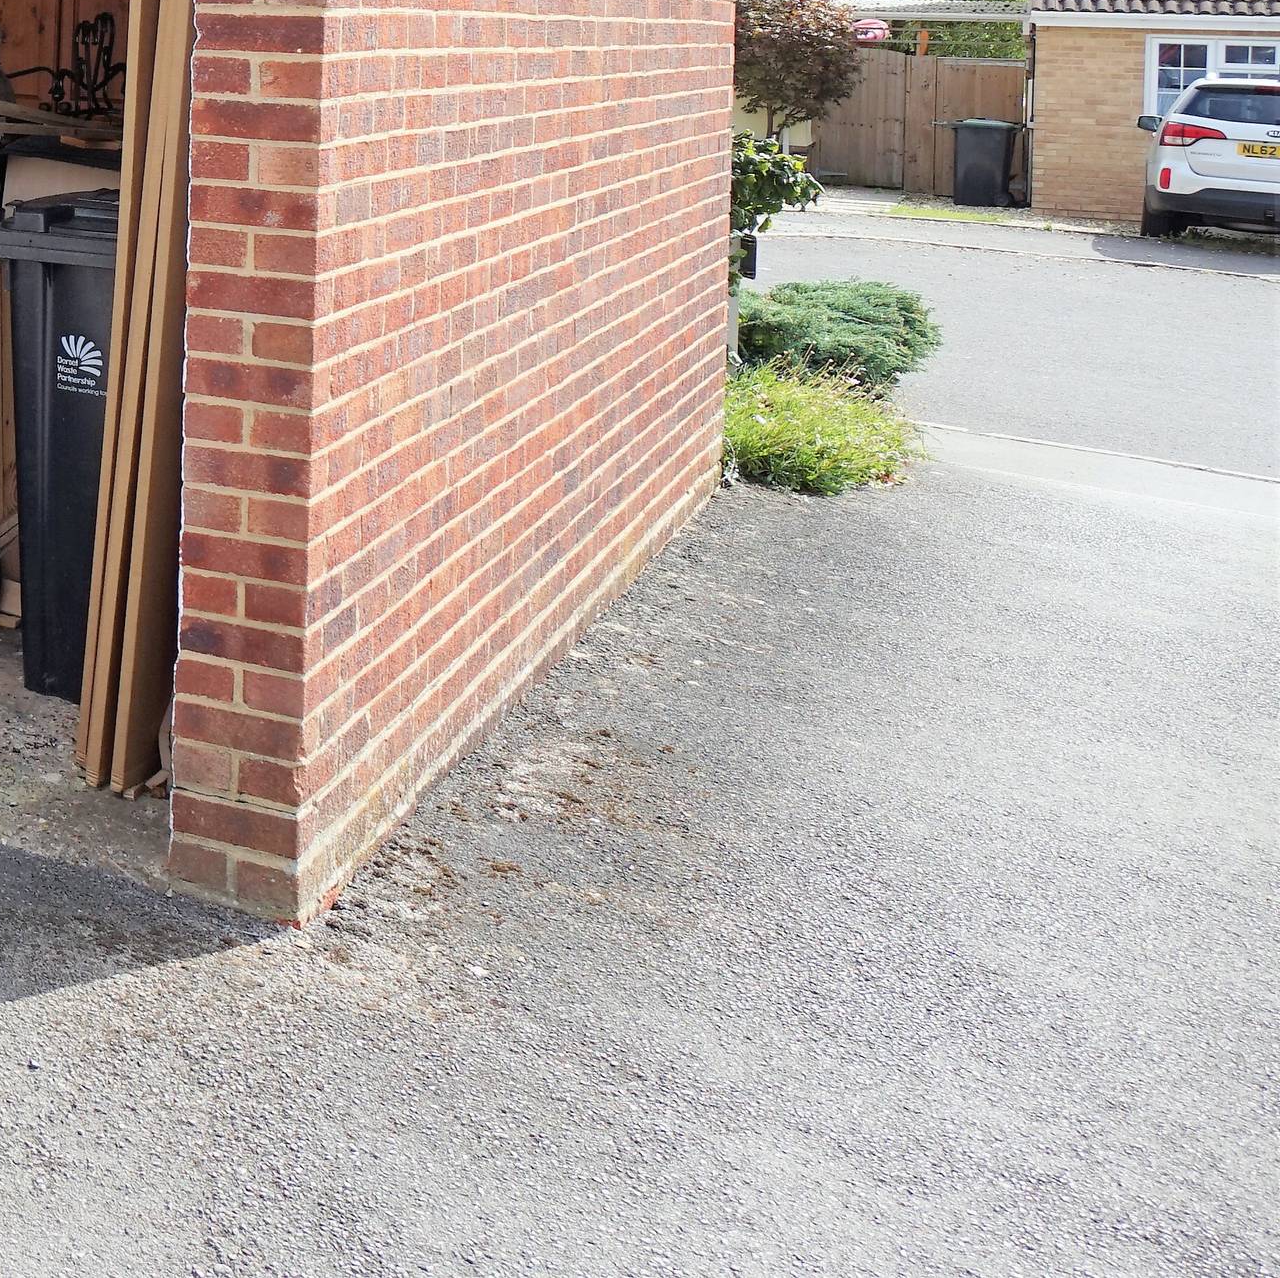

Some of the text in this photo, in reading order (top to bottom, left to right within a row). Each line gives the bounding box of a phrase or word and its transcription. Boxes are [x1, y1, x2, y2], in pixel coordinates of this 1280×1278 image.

[1243, 144, 1277, 155] NL62
[57, 356, 78, 366] Dorset
[57, 364, 77, 374] Waste
[57, 373, 95, 387] Partnership
